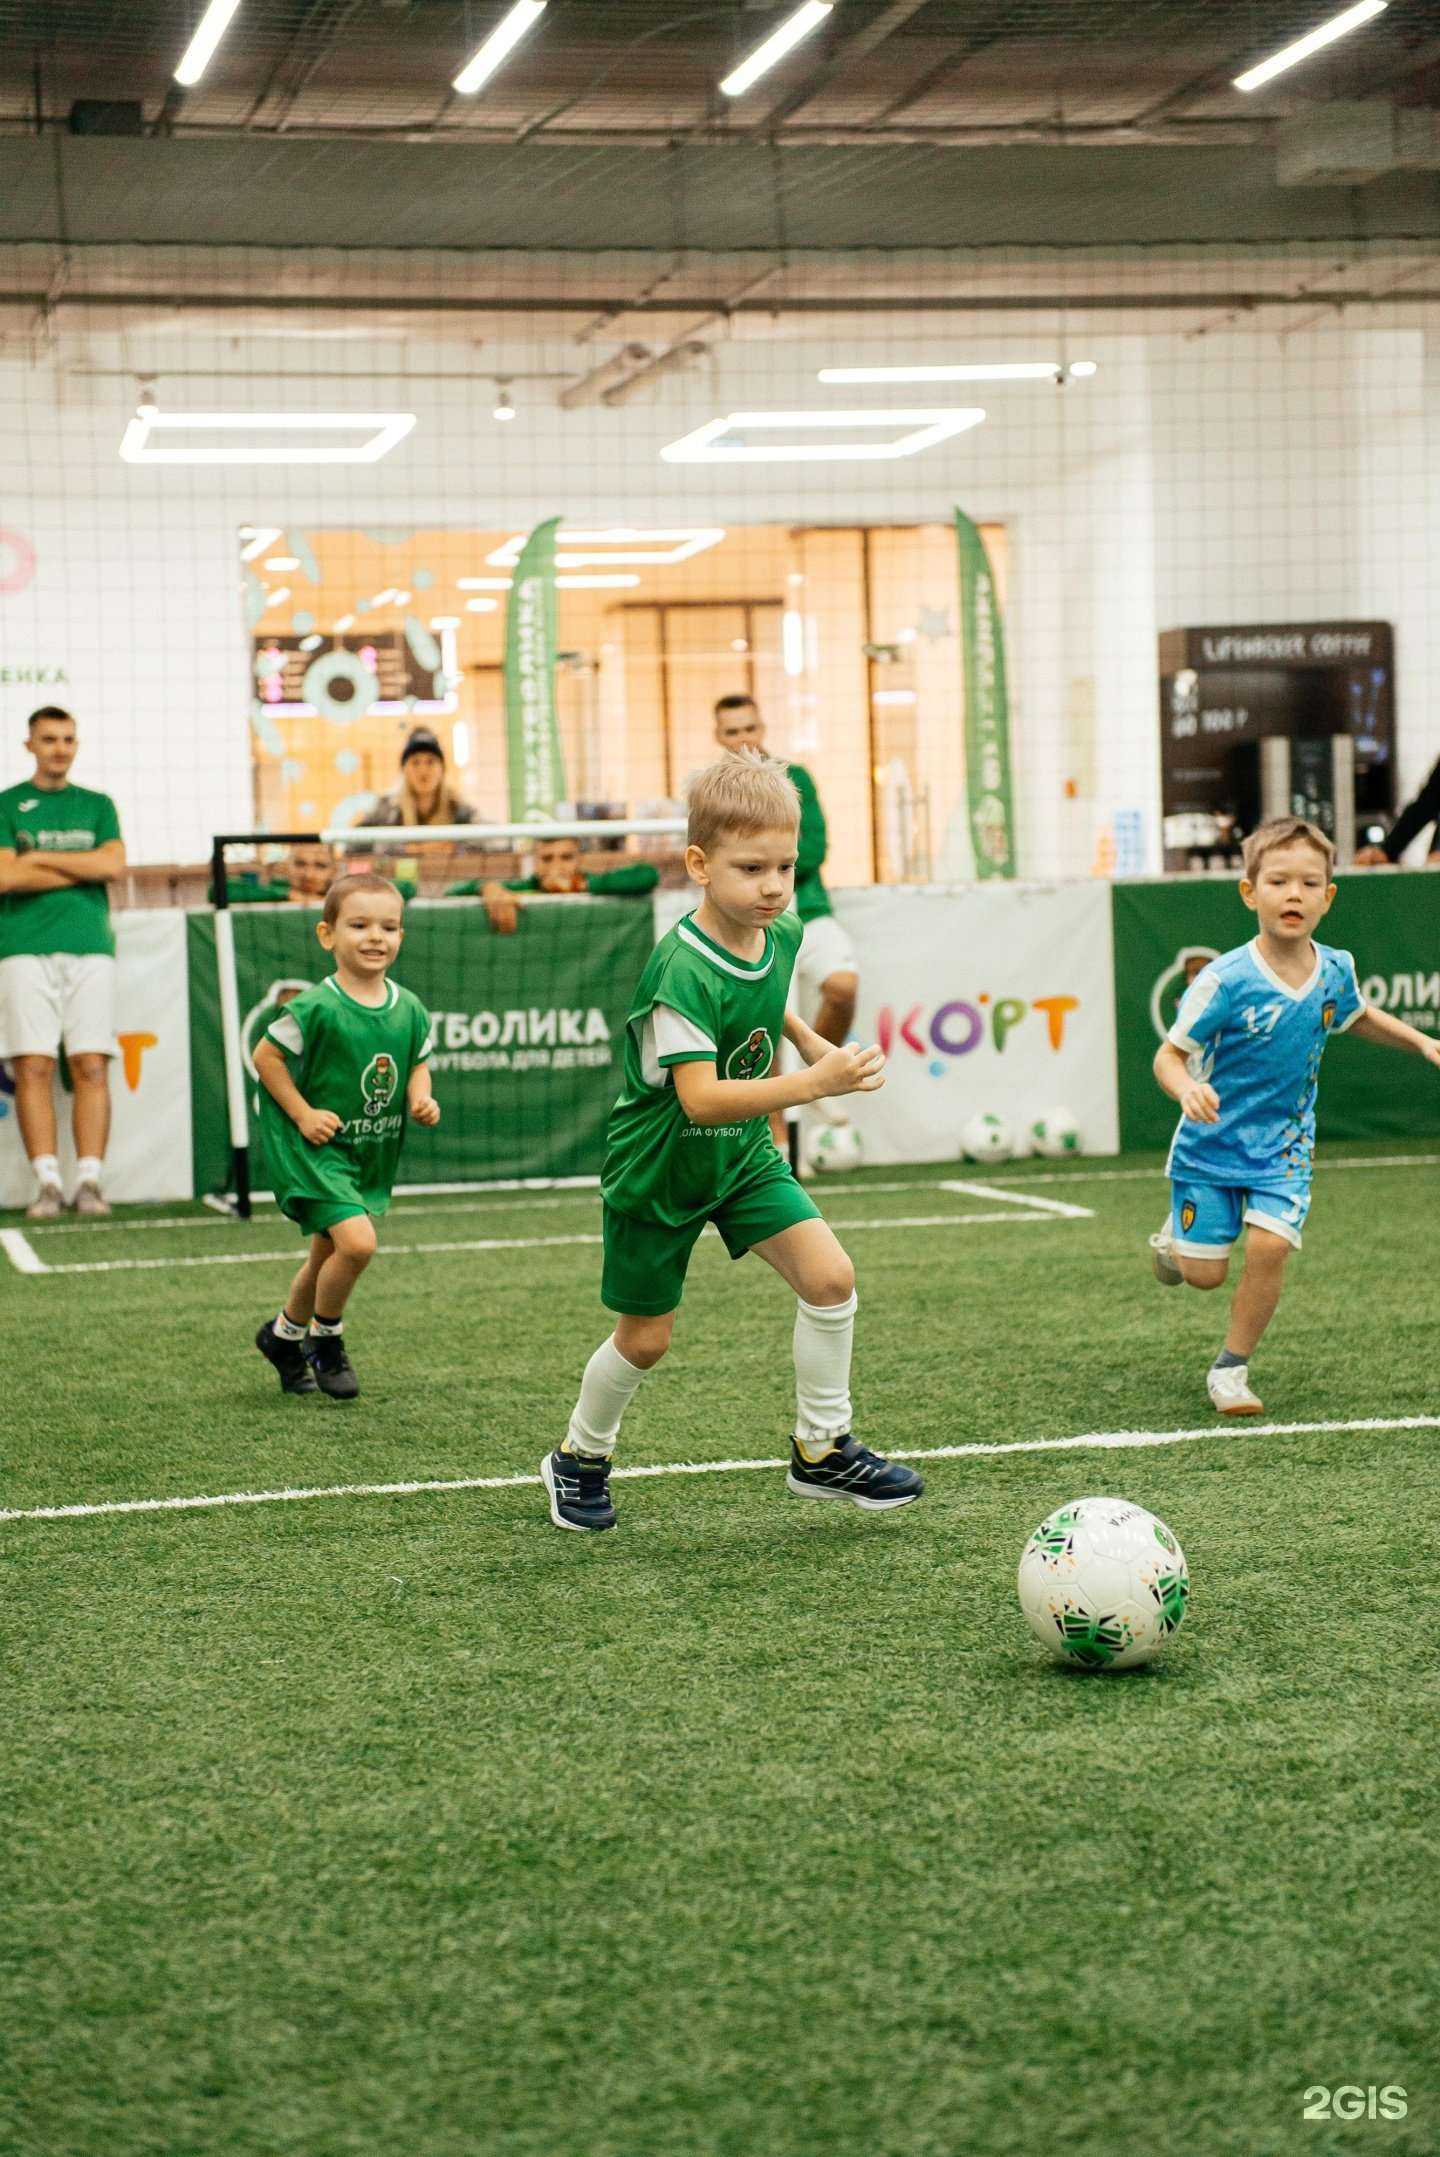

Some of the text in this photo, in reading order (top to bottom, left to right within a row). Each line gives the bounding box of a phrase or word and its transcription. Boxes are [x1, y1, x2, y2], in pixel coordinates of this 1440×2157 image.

[876, 996, 1079, 1057] КОРТ
[1242, 1005, 1283, 1034] 17
[680, 1127, 702, 1137] ОЛА
